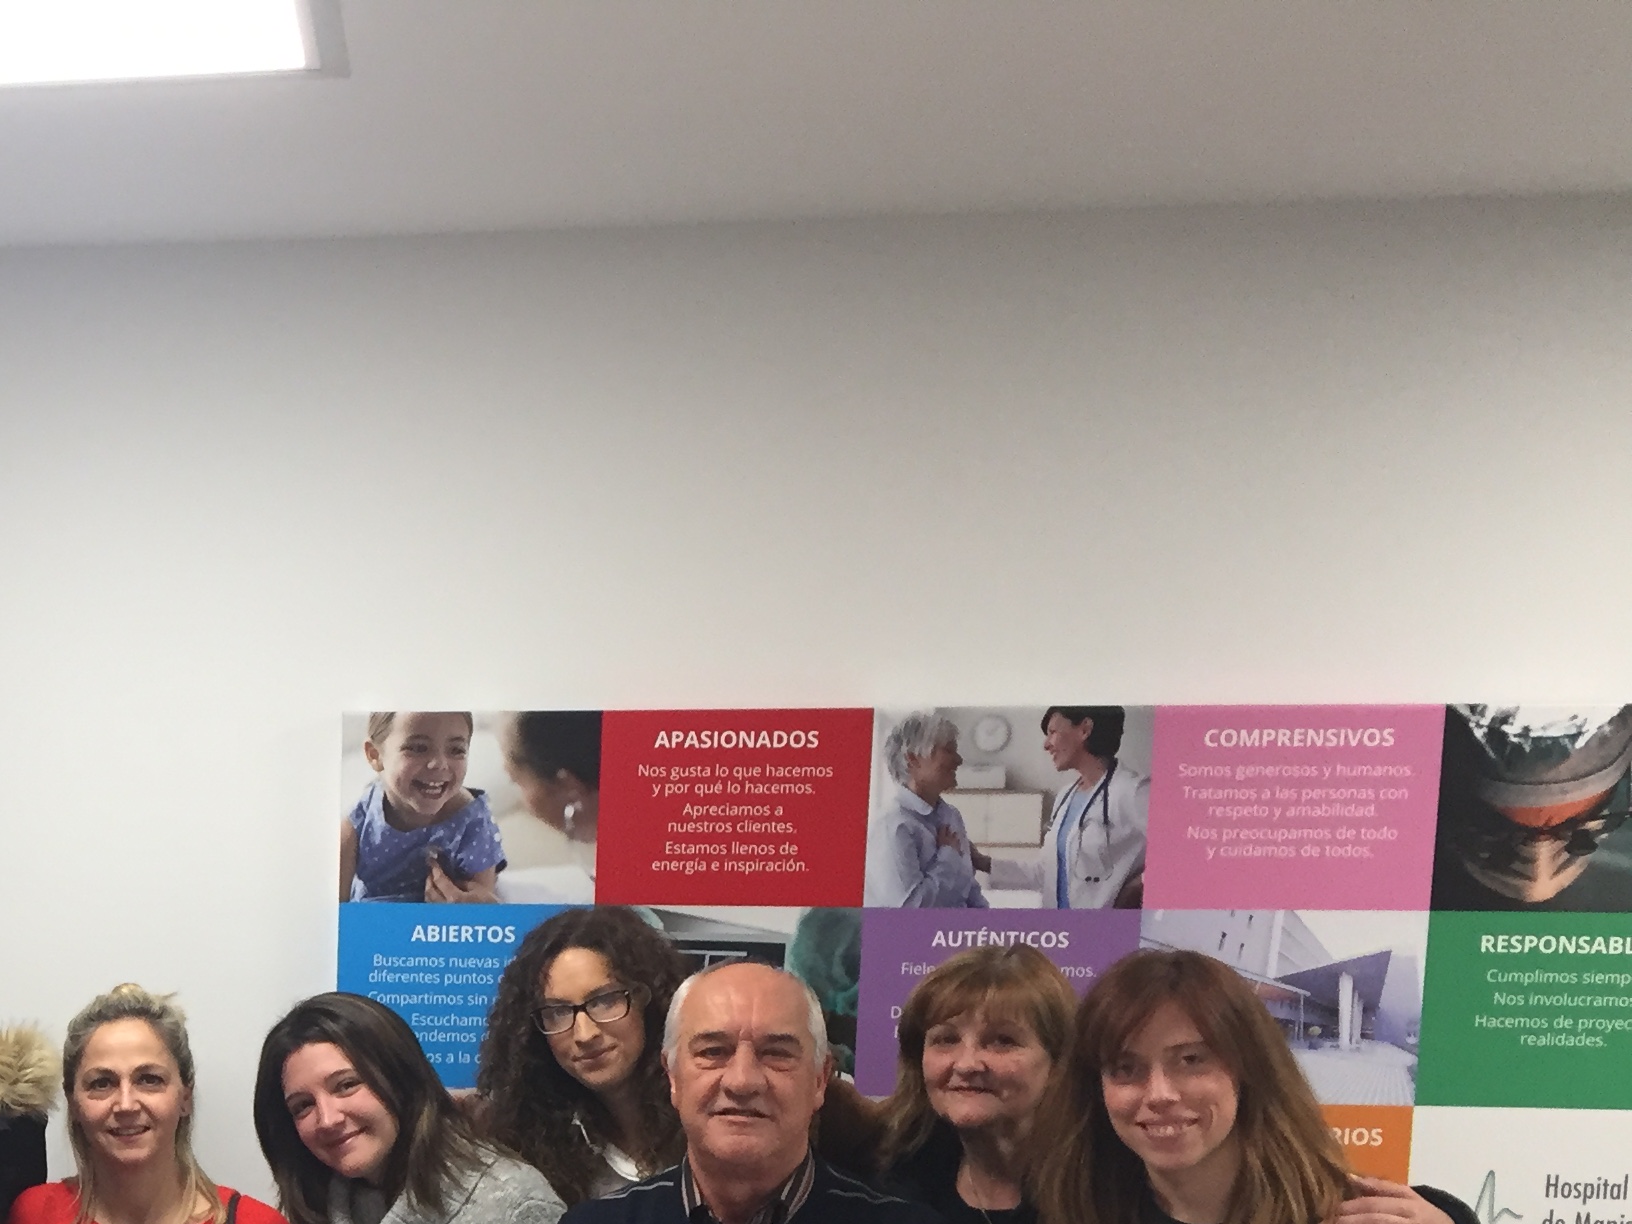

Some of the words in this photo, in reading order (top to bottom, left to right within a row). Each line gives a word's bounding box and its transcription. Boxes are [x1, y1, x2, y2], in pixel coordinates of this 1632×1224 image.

[654, 731, 819, 748] APASIONADOS
[1204, 728, 1395, 747] COMPRENSIVOS
[638, 764, 666, 777] Nos
[670, 765, 710, 780] gusta
[716, 764, 728, 777] lo
[733, 767, 761, 780] que
[766, 764, 833, 777] hacemos
[1178, 763, 1231, 777] Somos
[1235, 765, 1318, 780] generosos
[1322, 766, 1332, 777] y
[652, 783, 661, 797] y
[665, 783, 690, 797] por
[695, 780, 722, 797] qué
[728, 781, 740, 794] lo
[746, 782, 815, 794] hacemos.
[1183, 786, 1257, 800] Tratamos
[1261, 789, 1270, 799] a
[1275, 786, 1297, 800] las
[1301, 788, 1375, 802] personas
[1380, 789, 1408, 800] con
[683, 803, 770, 819] Apreciamos
[775, 806, 783, 815] a
[1209, 805, 1268, 819] respeto
[1273, 807, 1281, 821] y
[668, 822, 732, 833] nuestros
[737, 820, 797, 833] clientes.
[1187, 826, 1218, 840] Nos
[1223, 828, 1331, 842] preocupamos
[1336, 826, 1356, 840] de
[1361, 826, 1398, 840] todo
[665, 842, 727, 855] Estamos
[732, 842, 775, 855] llenos
[780, 842, 798, 855] de
[1206, 845, 1215, 860] y
[1220, 844, 1295, 857] cuidamos
[1301, 844, 1320, 857] de
[1325, 845, 1374, 858] todos.
[652, 858, 706, 875] energía
[711, 862, 719, 871] e
[725, 858, 809, 875] inspiración.
[411, 925, 515, 943] ABIERTOS
[932, 927, 1069, 949] AUTÉNTICOS
[1481, 935, 1632, 954] RESPONSABL
[373, 953, 445, 967] Buscamos
[449, 956, 499, 968] nuevas
[369, 970, 440, 983] diferentes
[444, 972, 494, 986] puntos
[1487, 969, 1577, 986] Cumplimos
[1583, 971, 1632, 987] siemp
[468, 993, 488, 1006] sin
[1494, 992, 1524, 1006] Nos
[1475, 1015, 1548, 1028] Hacemos
[1554, 1015, 1573, 1028] de
[1578, 1018, 1632, 1034] proyec
[1520, 1033, 1607, 1047] realidades.
[446, 1054, 454, 1063] a
[459, 1051, 470, 1063] la
[1545, 1173, 1628, 1204] Hospital
